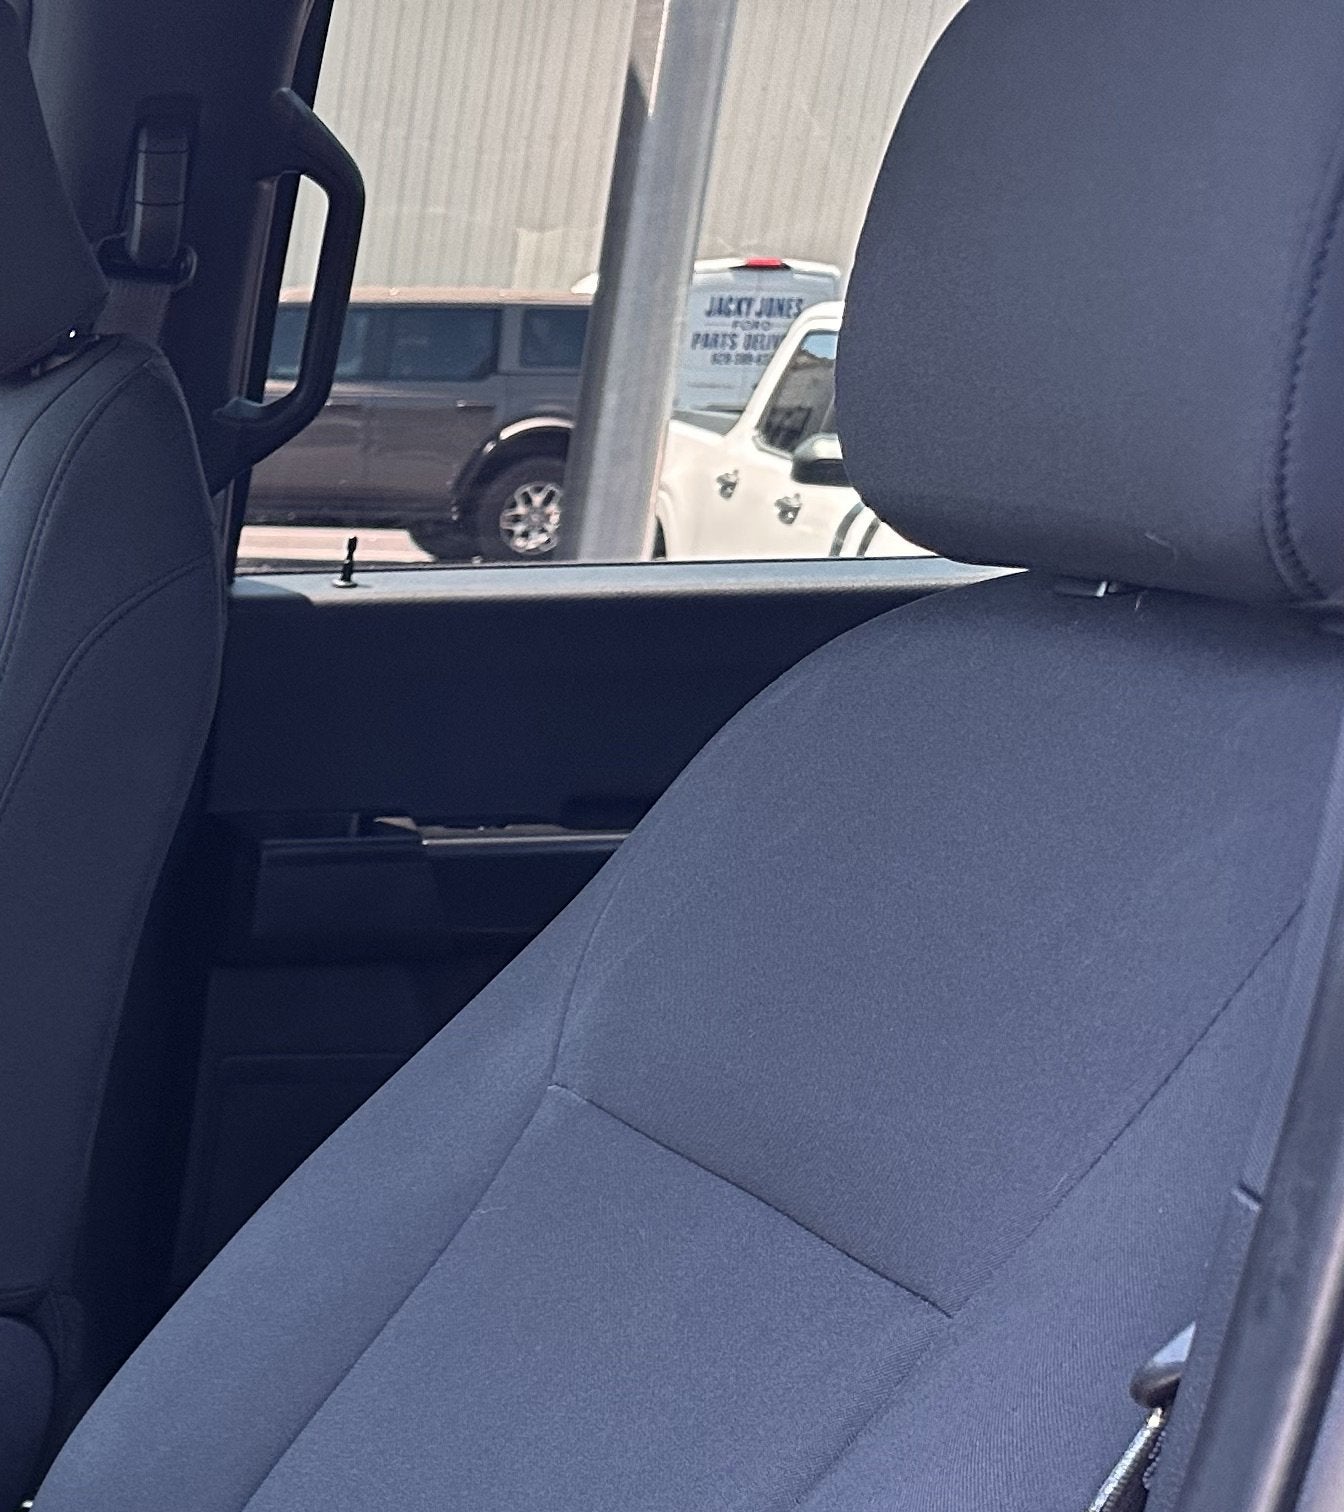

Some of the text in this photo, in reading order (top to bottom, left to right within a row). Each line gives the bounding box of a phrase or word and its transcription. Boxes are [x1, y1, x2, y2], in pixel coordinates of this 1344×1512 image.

[705, 296, 804, 318] JACKY JONES
[691, 333, 787, 350] PARTS DELIV
